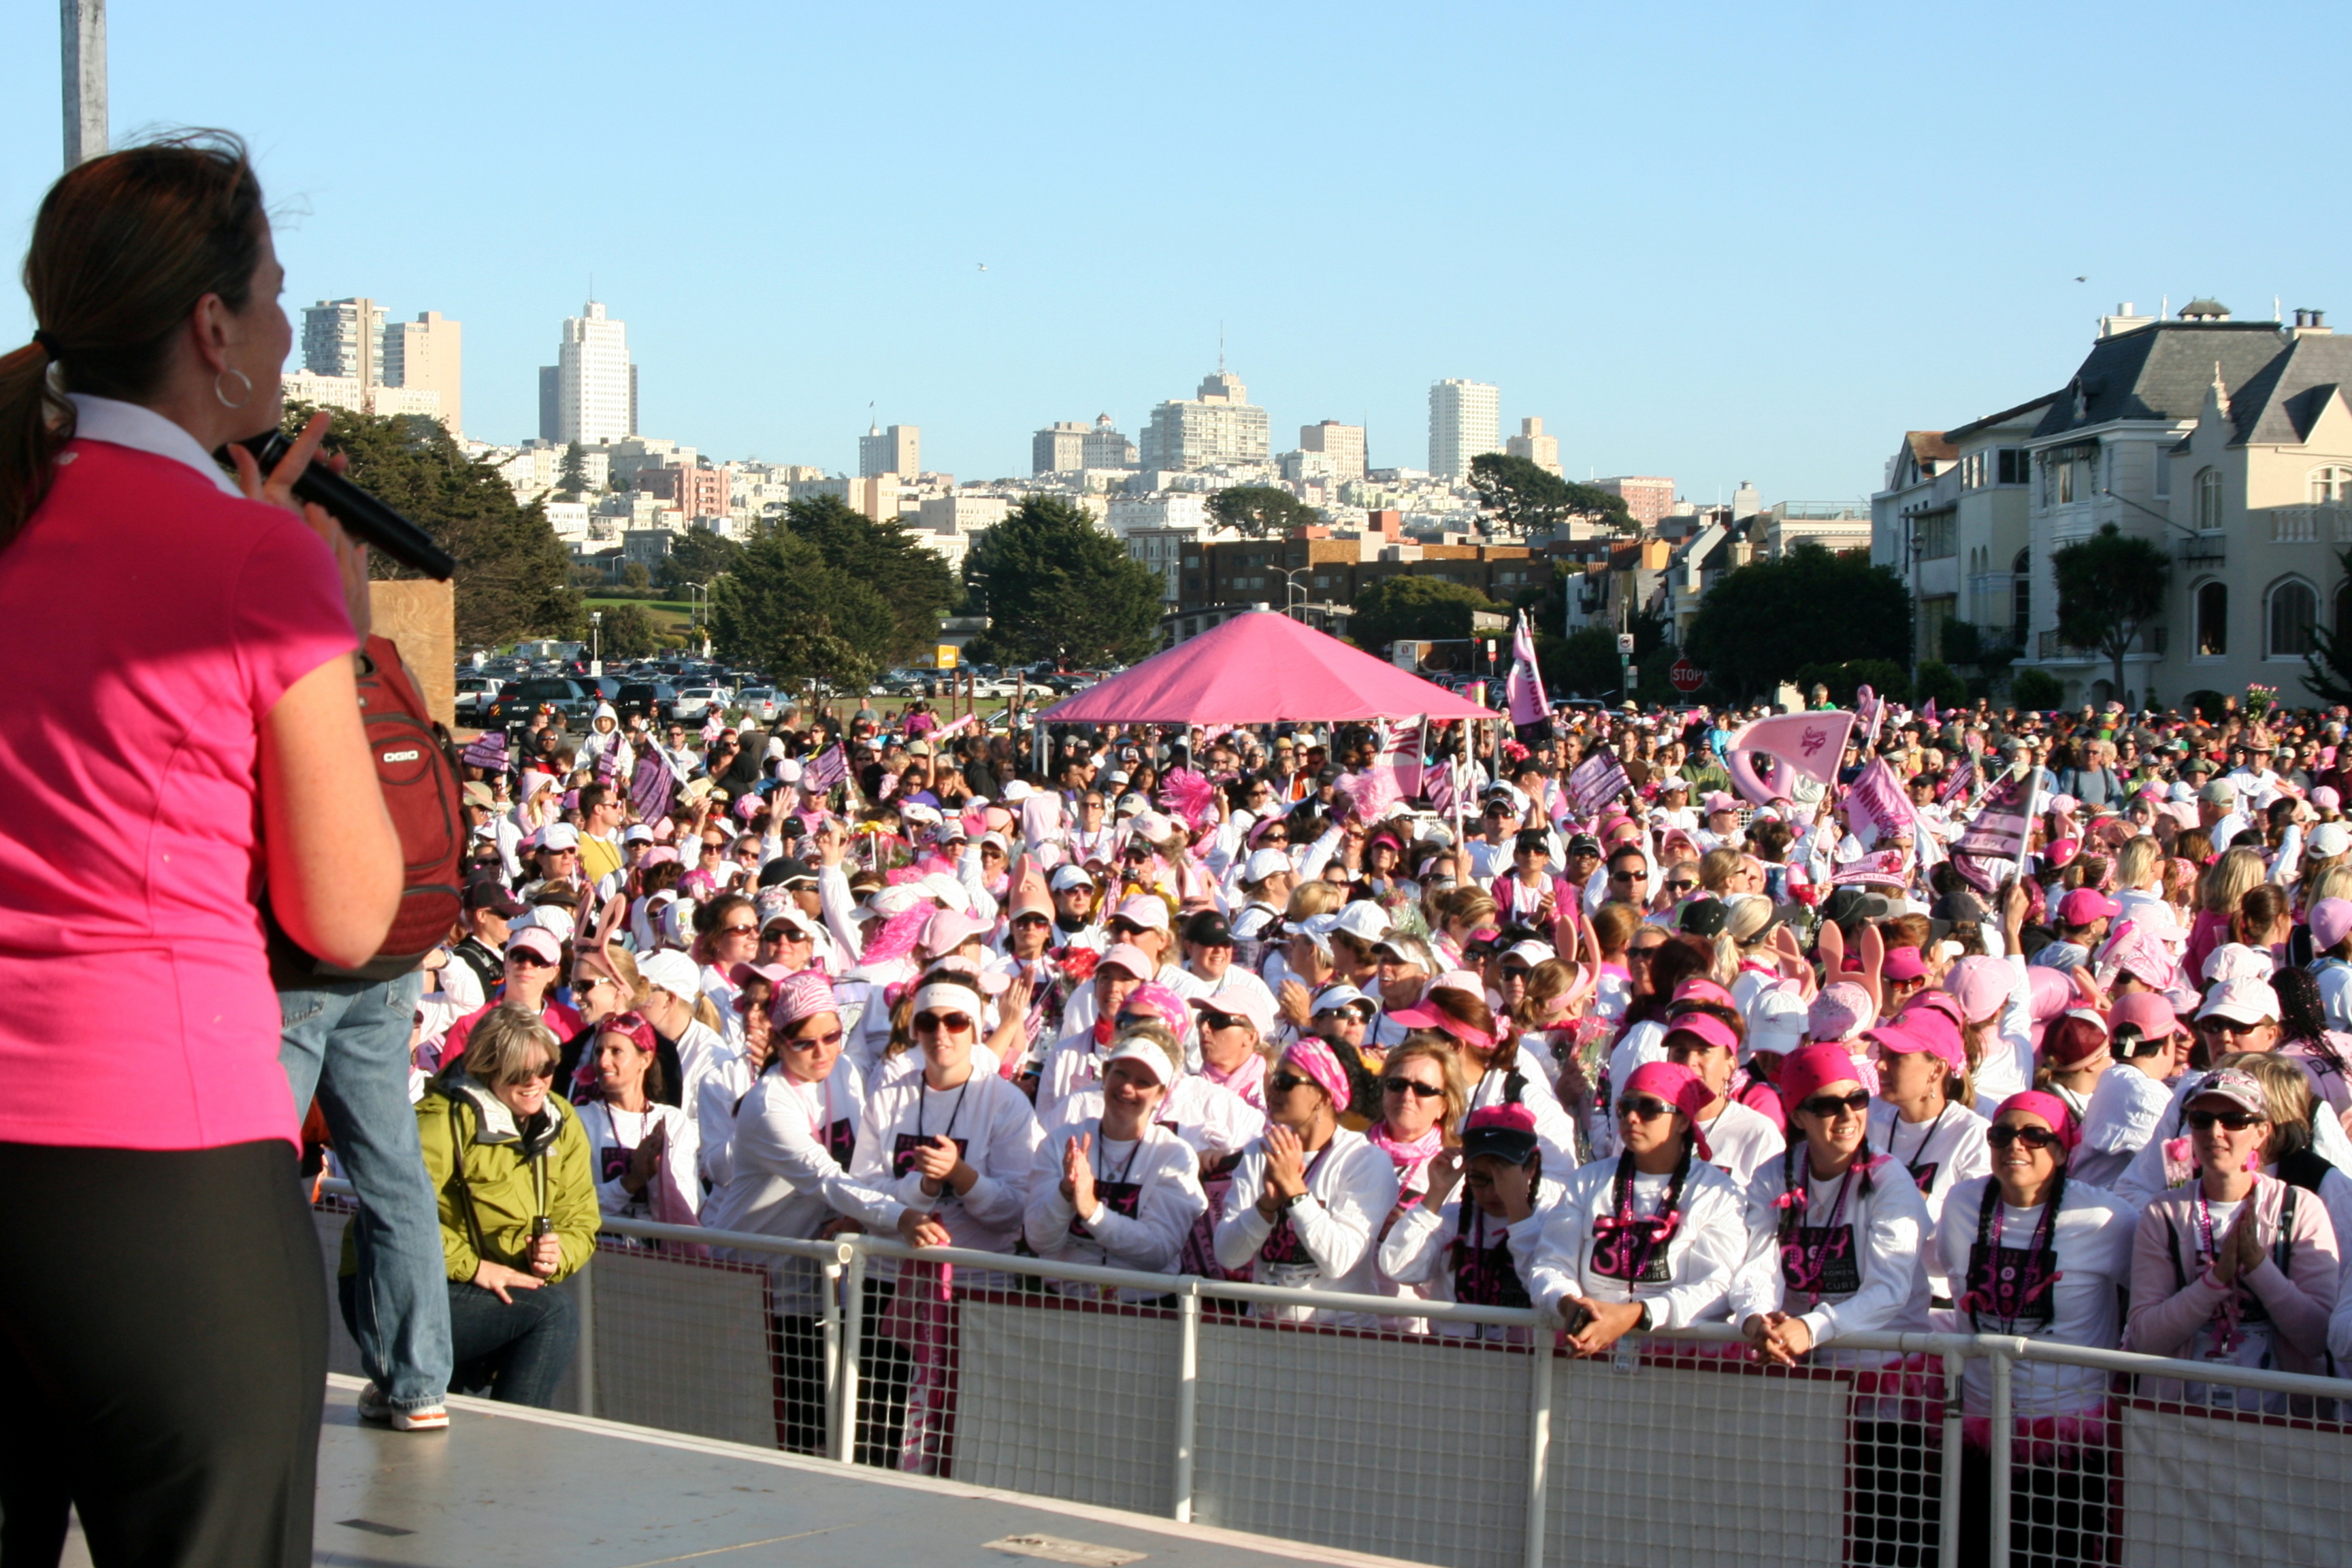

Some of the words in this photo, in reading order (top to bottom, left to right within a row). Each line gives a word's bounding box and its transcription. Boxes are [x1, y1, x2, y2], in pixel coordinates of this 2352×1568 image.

[1673, 668, 1702, 681] STOP
[383, 750, 419, 763] OGIO
[1826, 1282, 1857, 1290] CURE
